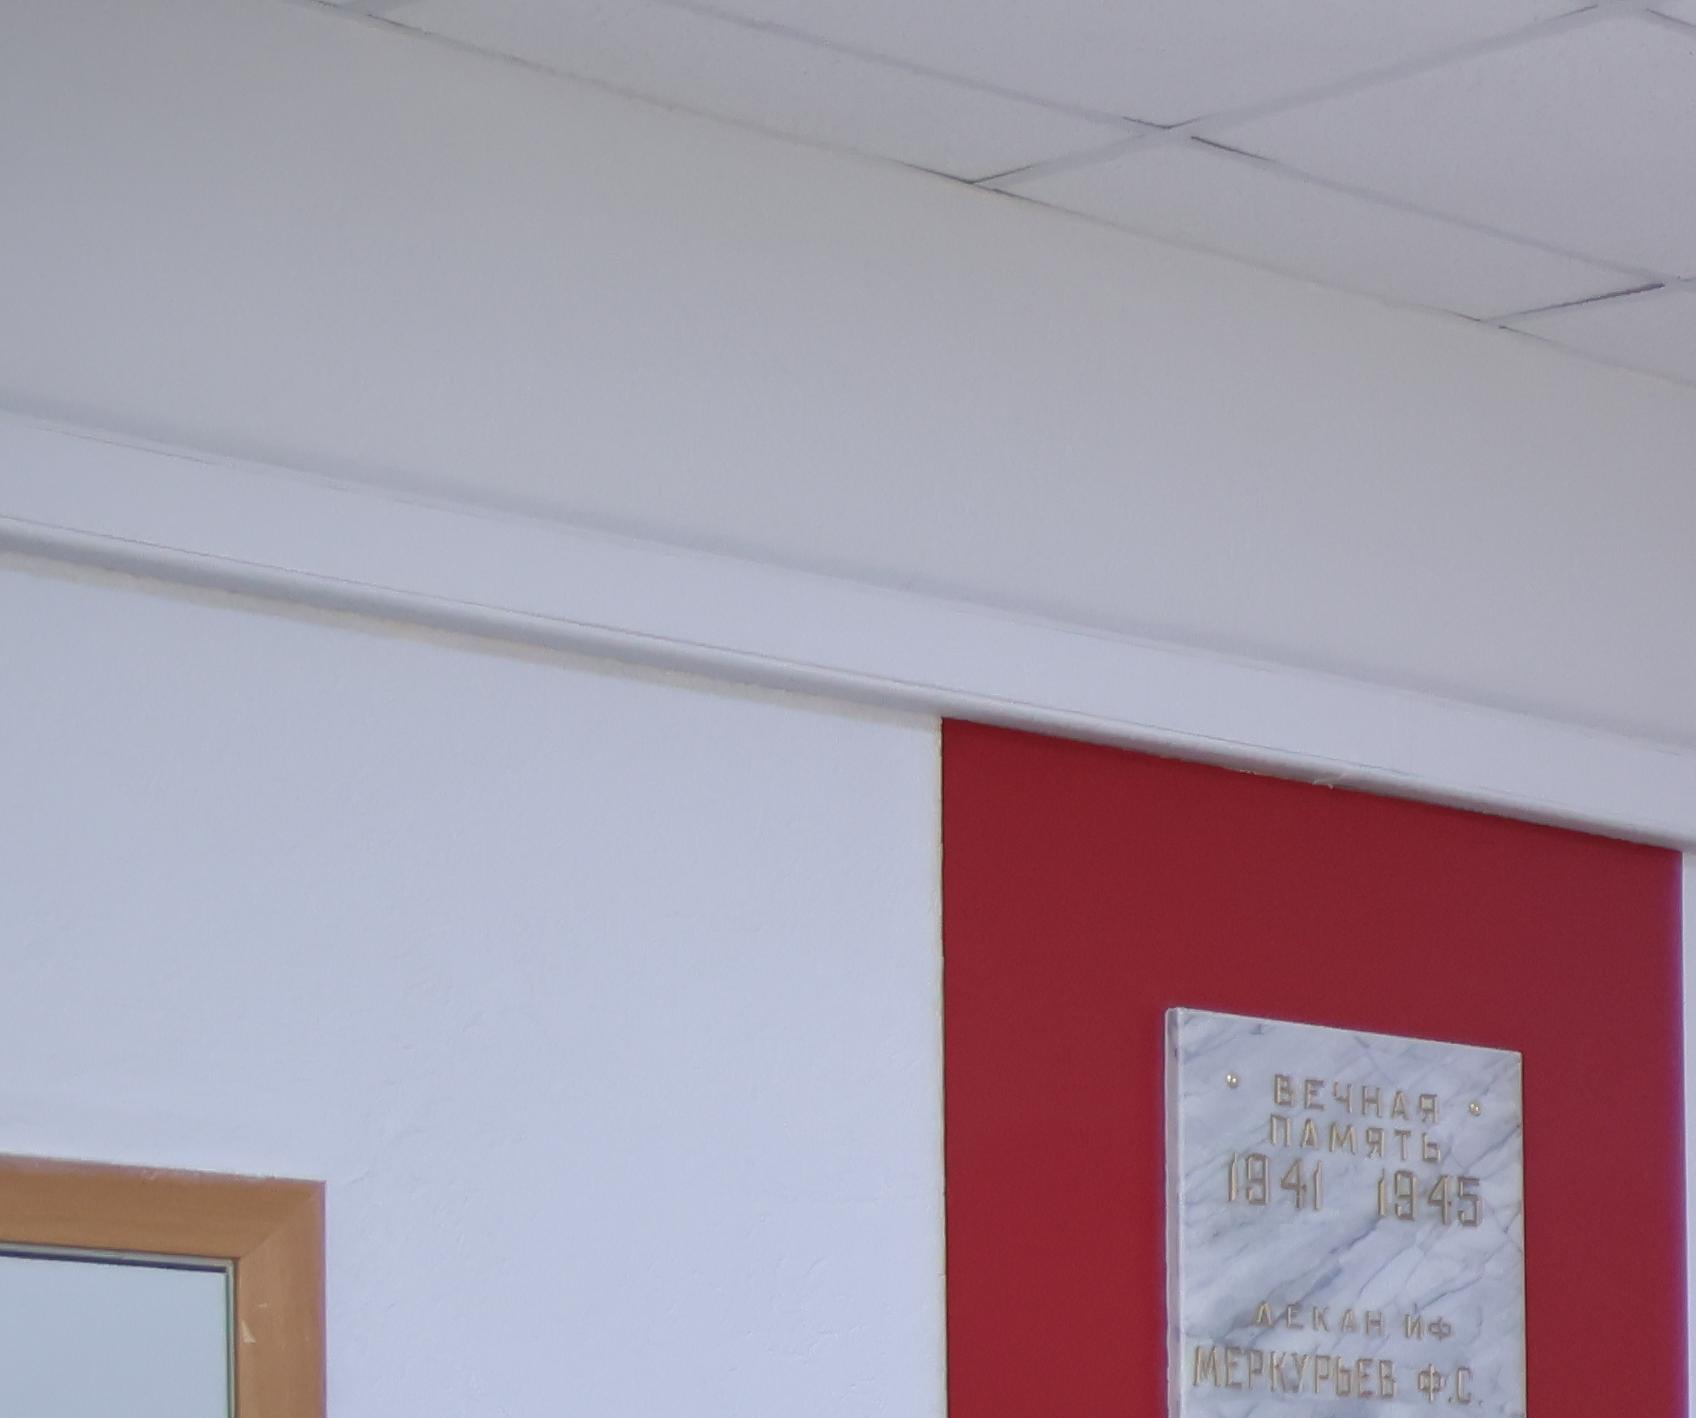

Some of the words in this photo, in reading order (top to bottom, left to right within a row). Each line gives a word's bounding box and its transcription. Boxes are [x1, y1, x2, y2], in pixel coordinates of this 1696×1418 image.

[1273, 1074, 1439, 1124] ВЕЧНАЯ
[1269, 1114, 1441, 1163] ПАМЯТЬ
[1227, 1152, 1323, 1211] 1941
[1377, 1168, 1484, 1227] 1945
[1254, 1302, 1386, 1337] ДЕКАН
[1404, 1313, 1453, 1341] ИФ
[1193, 1346, 1396, 1399] МЕРКУРЬЕВ
